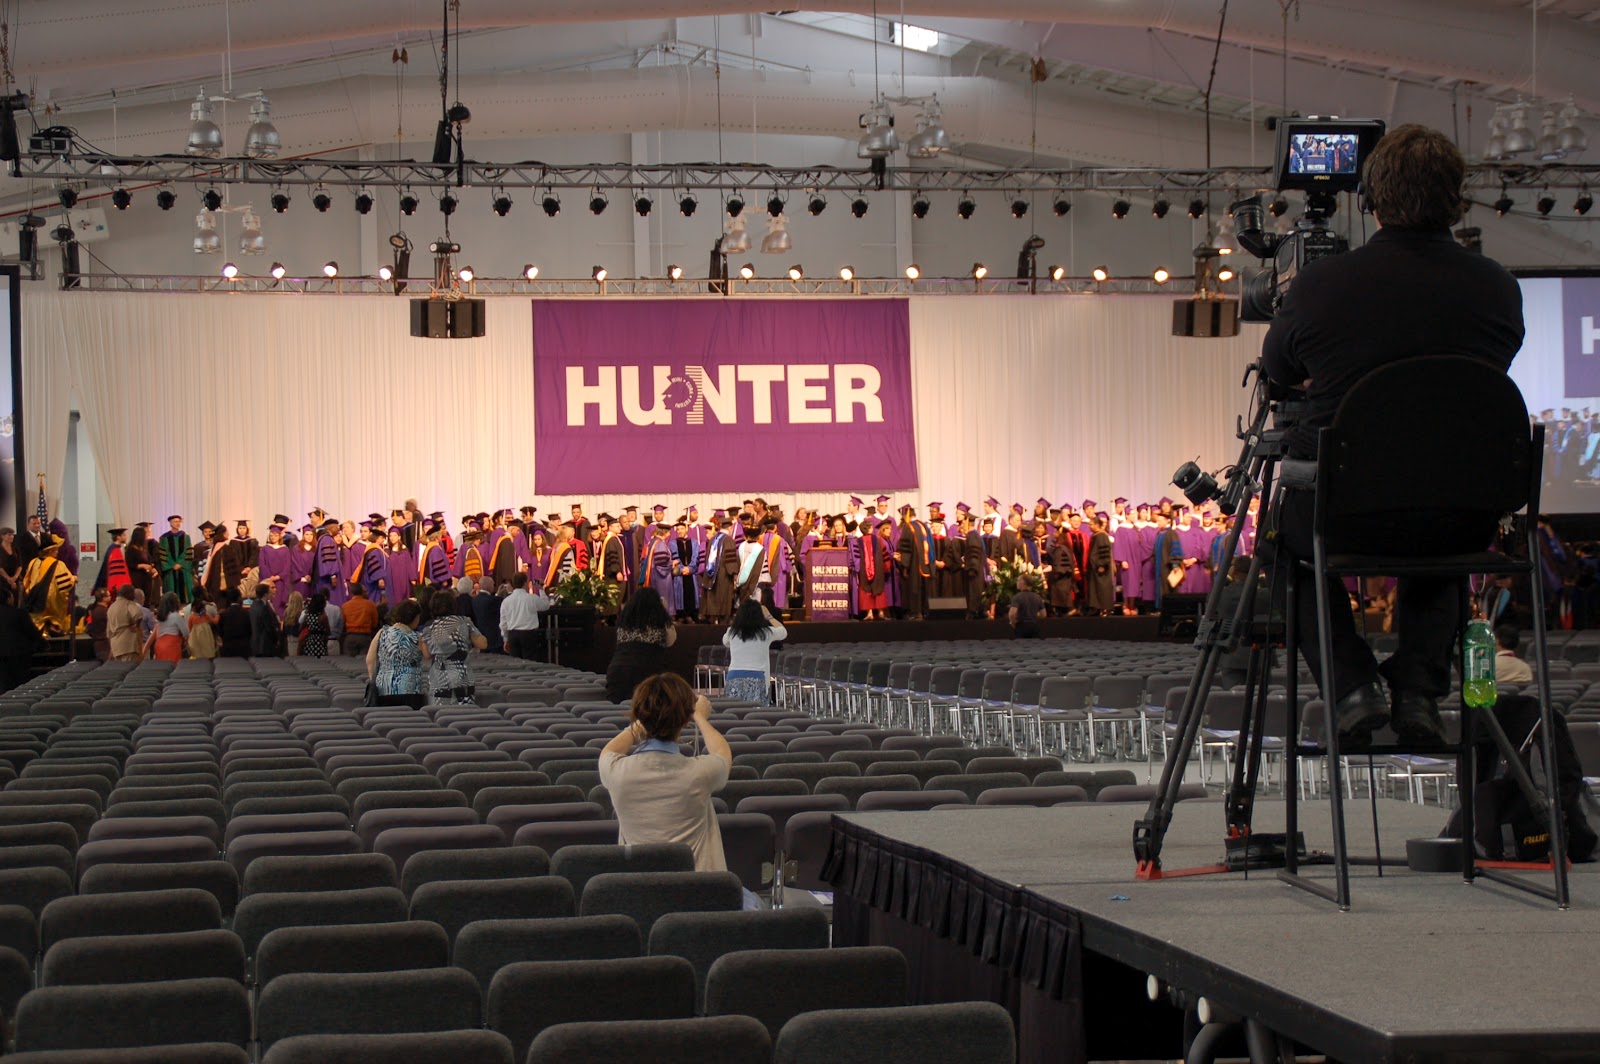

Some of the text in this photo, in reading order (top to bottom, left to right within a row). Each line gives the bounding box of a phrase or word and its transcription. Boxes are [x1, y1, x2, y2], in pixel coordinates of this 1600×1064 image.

[566, 364, 884, 426] HUNTER
[812, 566, 848, 574] HUNTER
[812, 582, 848, 590] HUNTER
[812, 600, 848, 608] HUNTER
